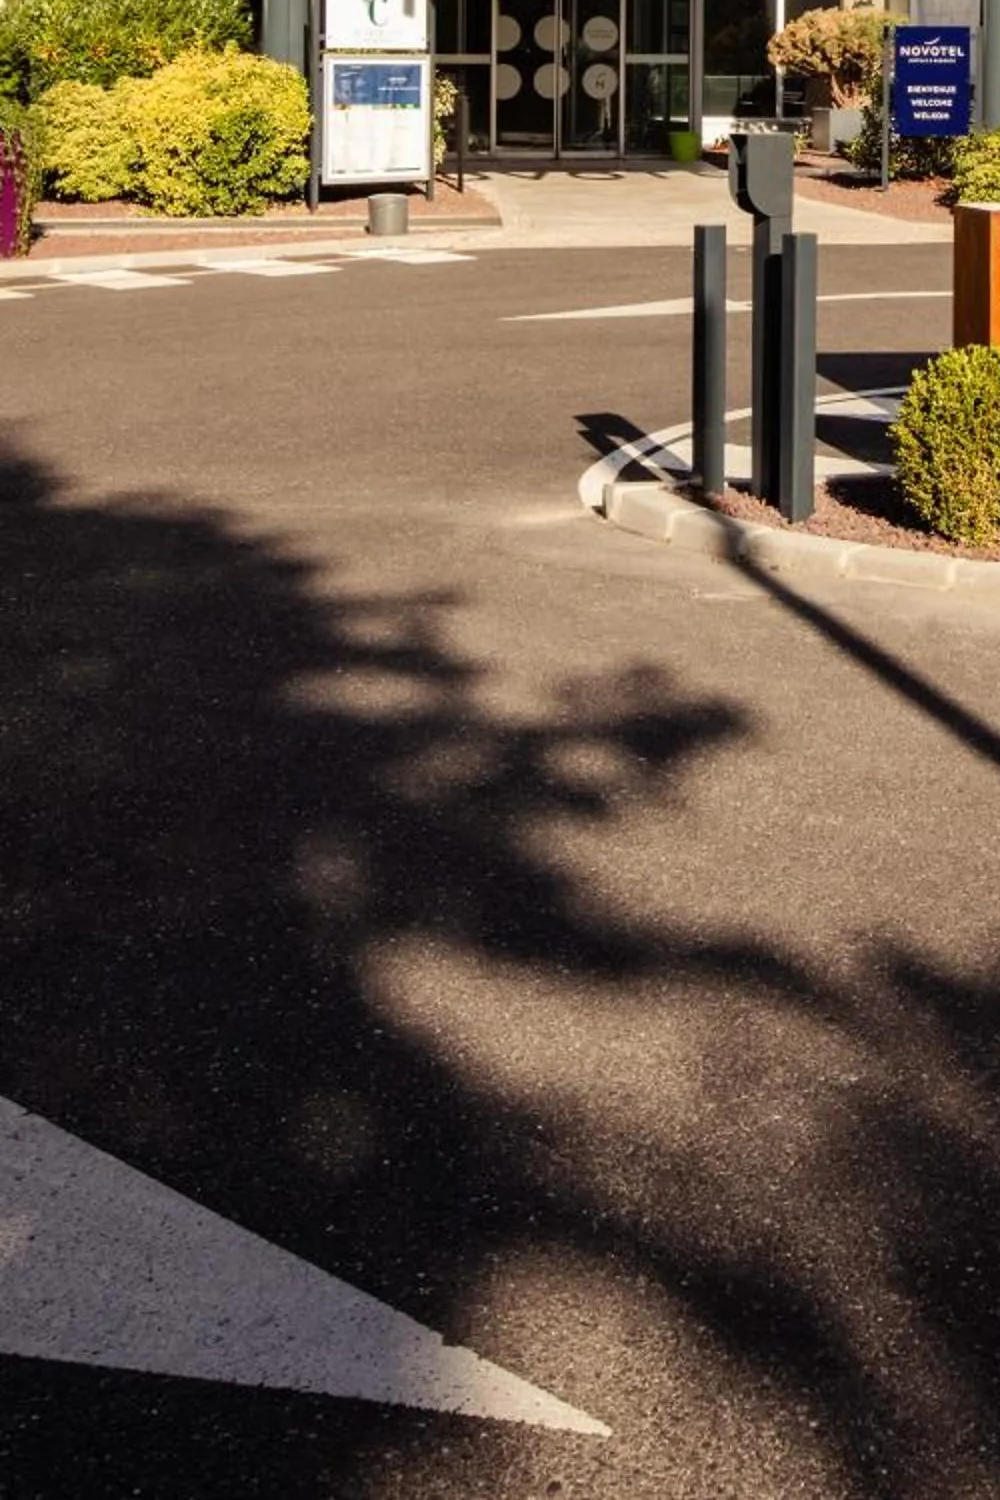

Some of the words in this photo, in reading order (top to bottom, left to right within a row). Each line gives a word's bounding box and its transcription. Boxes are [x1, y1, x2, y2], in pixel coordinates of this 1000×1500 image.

[900, 45, 965, 57] NOVOTEL
[907, 85, 957, 94] BIENVENUE
[911, 99, 953, 107] WELCOME
